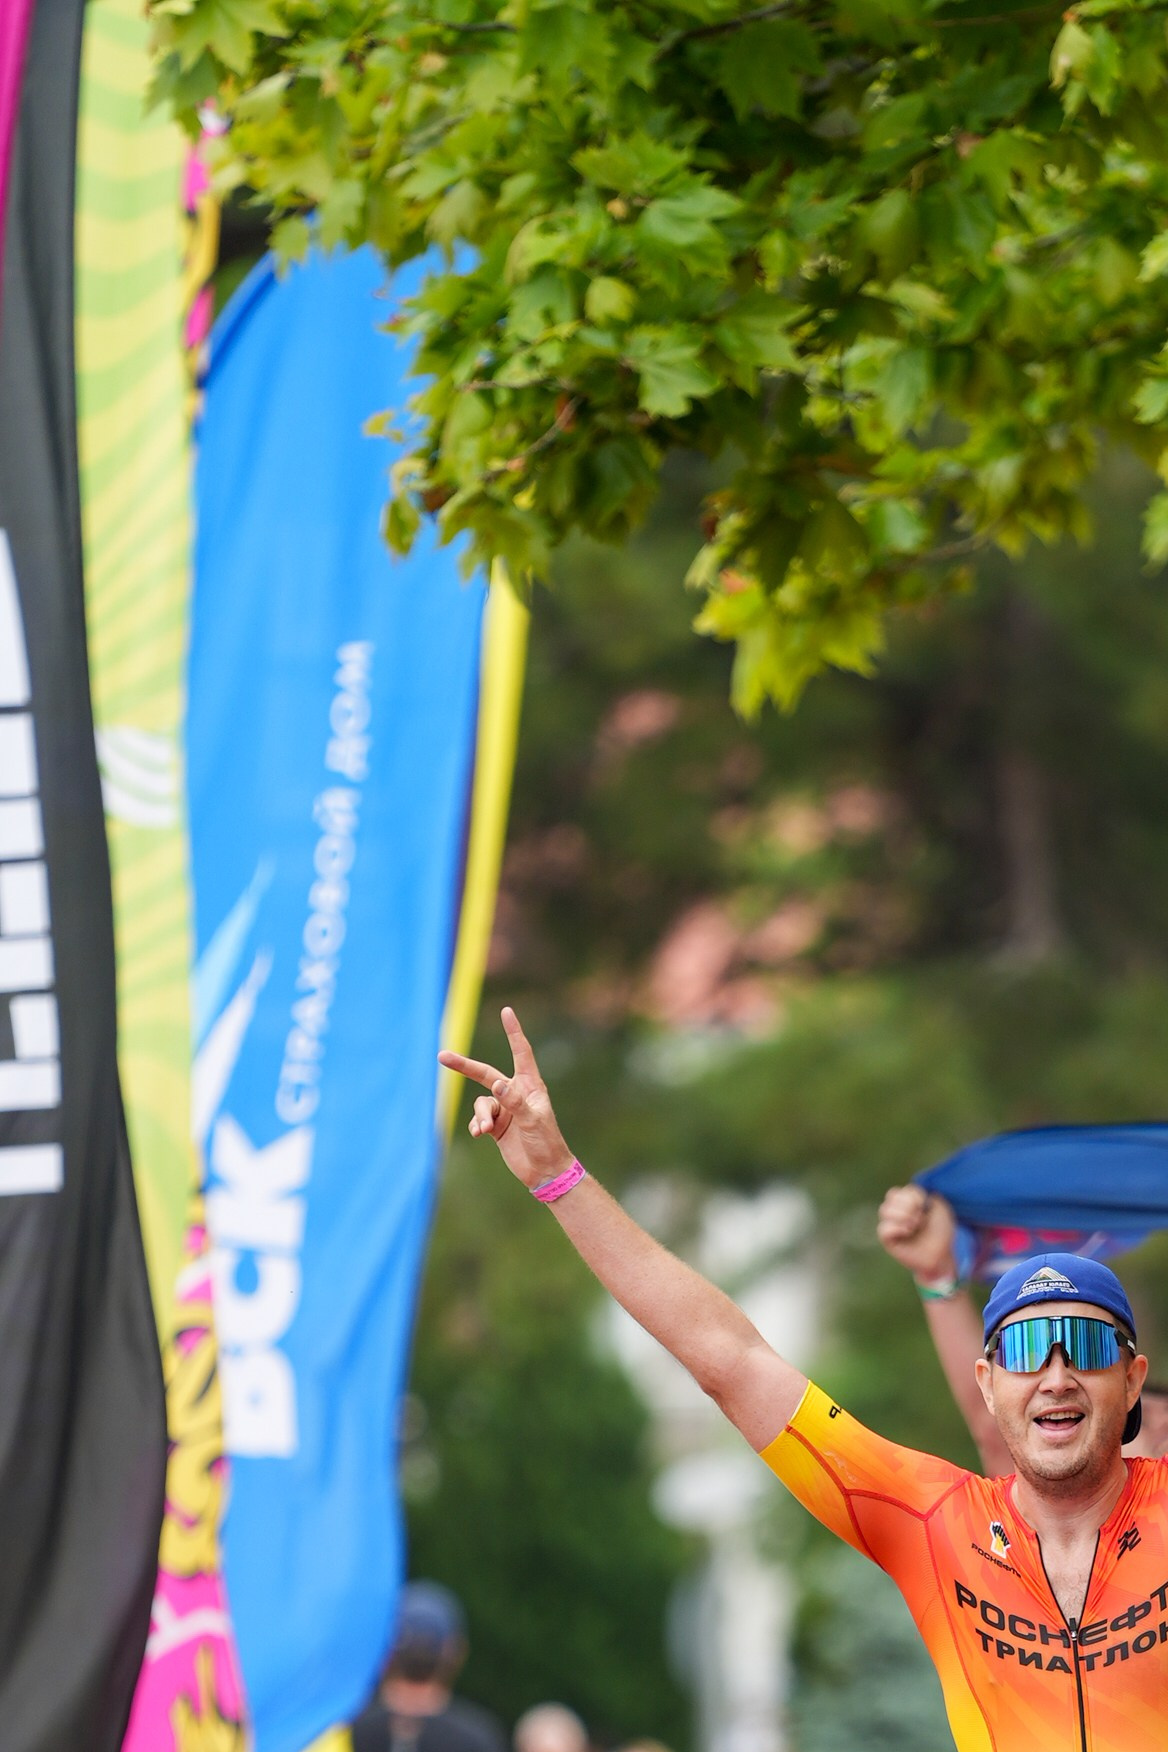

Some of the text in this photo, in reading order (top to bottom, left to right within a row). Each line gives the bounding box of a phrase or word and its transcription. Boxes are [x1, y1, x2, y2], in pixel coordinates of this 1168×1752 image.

[325, 640, 375, 782] ДОМ
[206, 1115, 315, 1458] ВСК
[971, 1543, 1022, 1578] РОСНЕФТЬ
